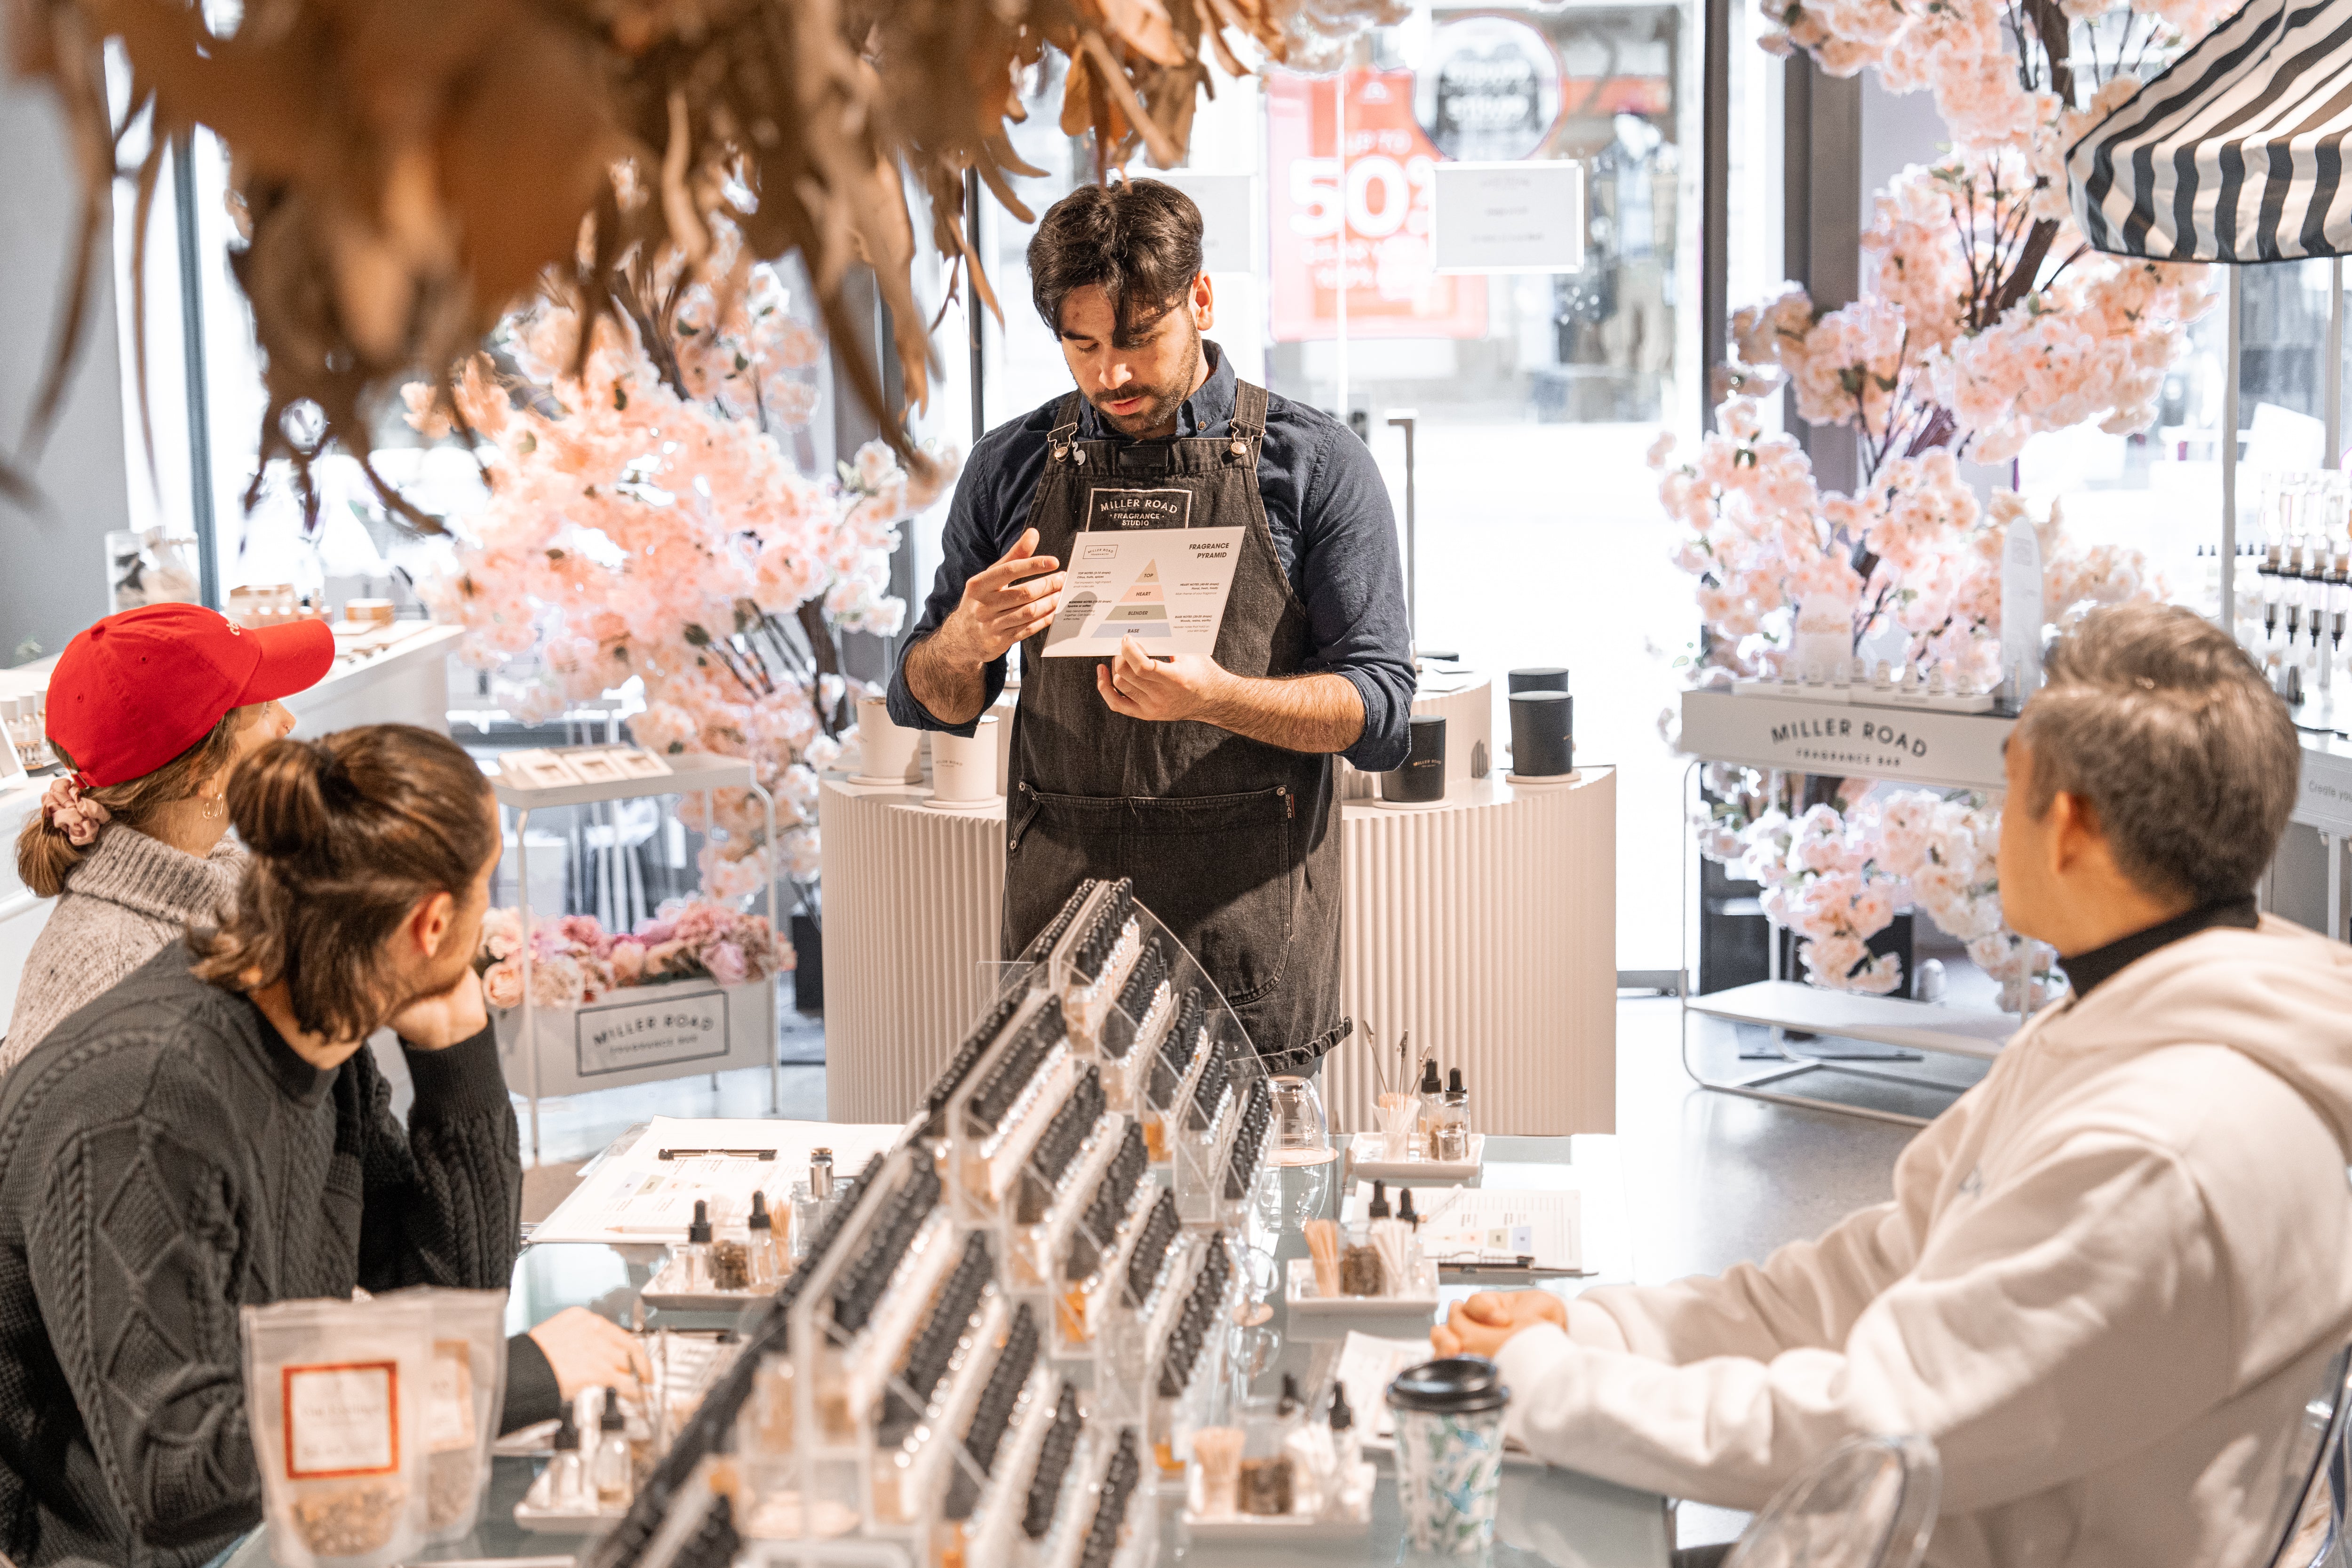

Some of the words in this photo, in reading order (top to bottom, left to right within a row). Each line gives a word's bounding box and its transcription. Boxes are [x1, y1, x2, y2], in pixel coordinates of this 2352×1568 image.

[1100, 499, 1140, 511] MILLER
[1144, 499, 1177, 513] ROAD
[1771, 717, 1852, 744] MILLER
[1862, 721, 1928, 758] ROAD
[1413, 759, 1430, 767] MILLER
[594, 1015, 656, 1045] MILLER
[663, 1013, 714, 1032] ROAD
